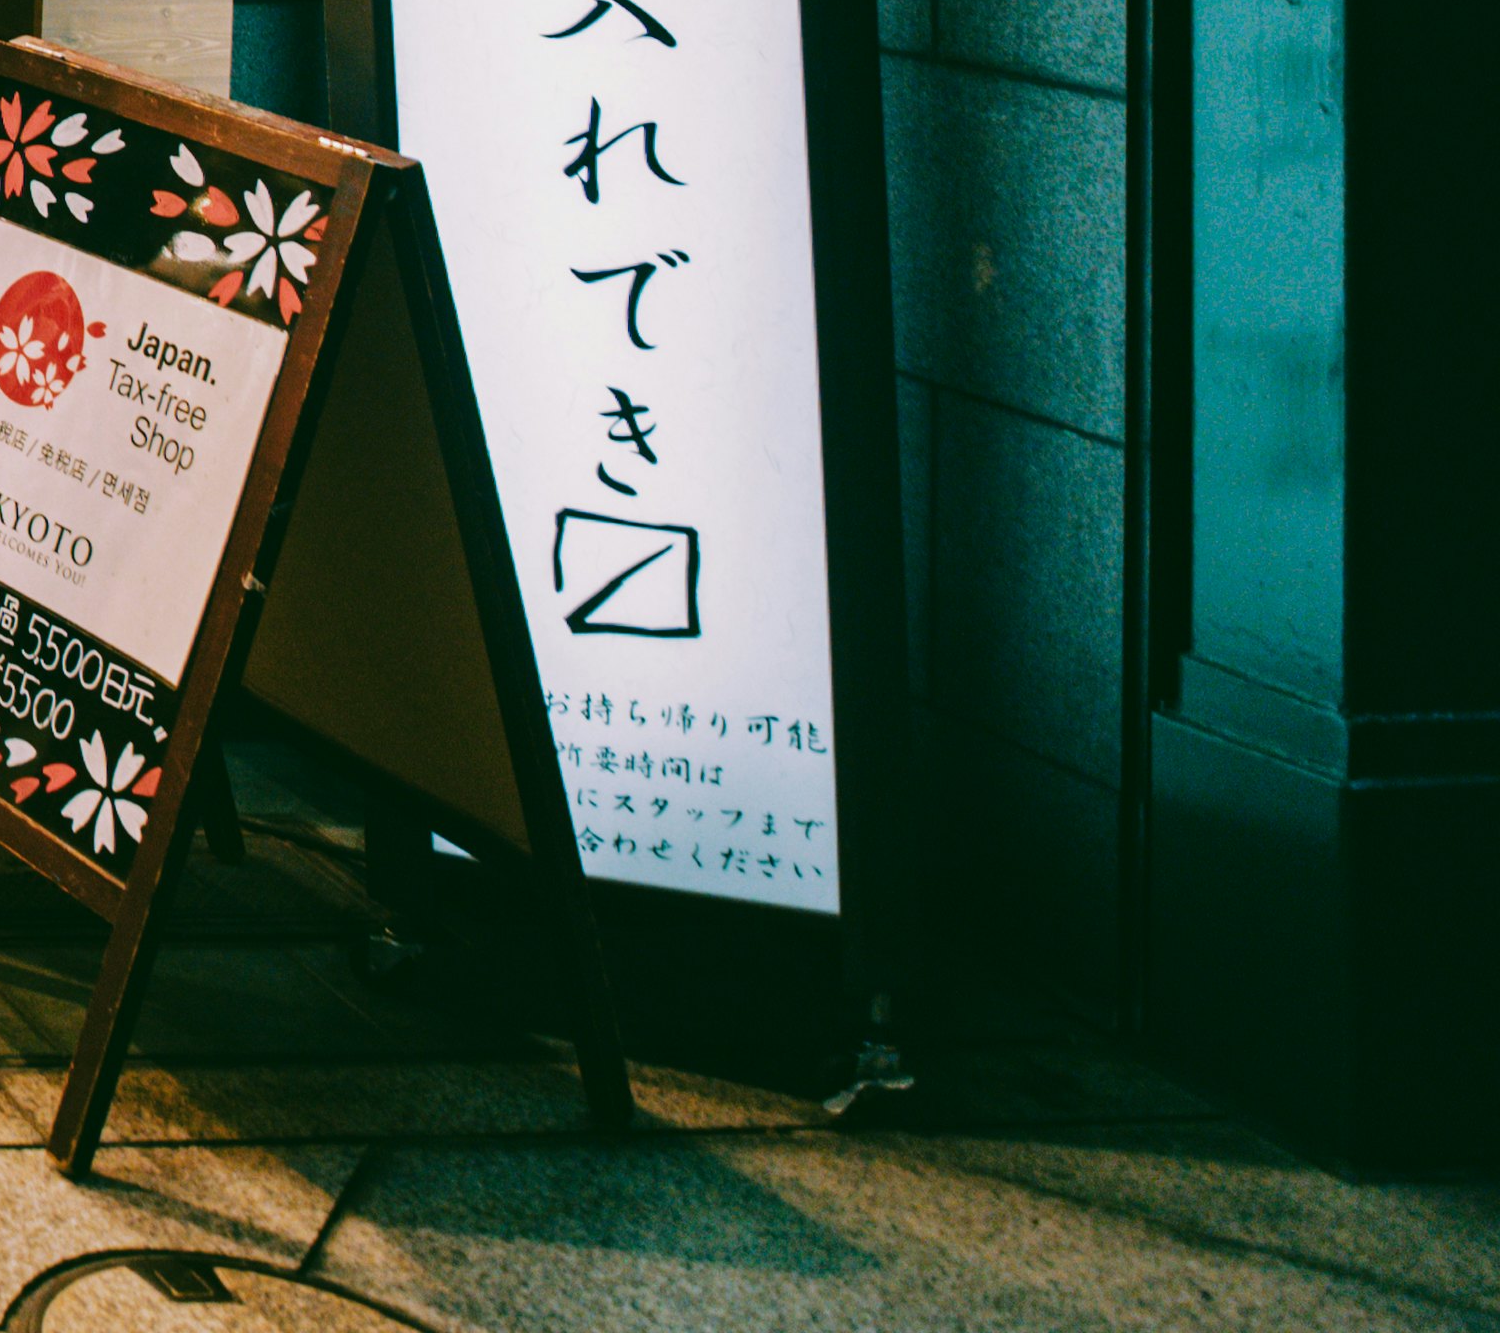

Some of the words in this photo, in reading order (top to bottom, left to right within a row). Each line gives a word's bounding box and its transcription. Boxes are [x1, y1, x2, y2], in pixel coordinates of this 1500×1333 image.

[127, 319, 217, 387] Japan.
[107, 357, 209, 434] Tax-free
[129, 416, 196, 475] Shop
[101, 470, 151, 514] 면세점
[54, 560, 88, 589] YOU!
